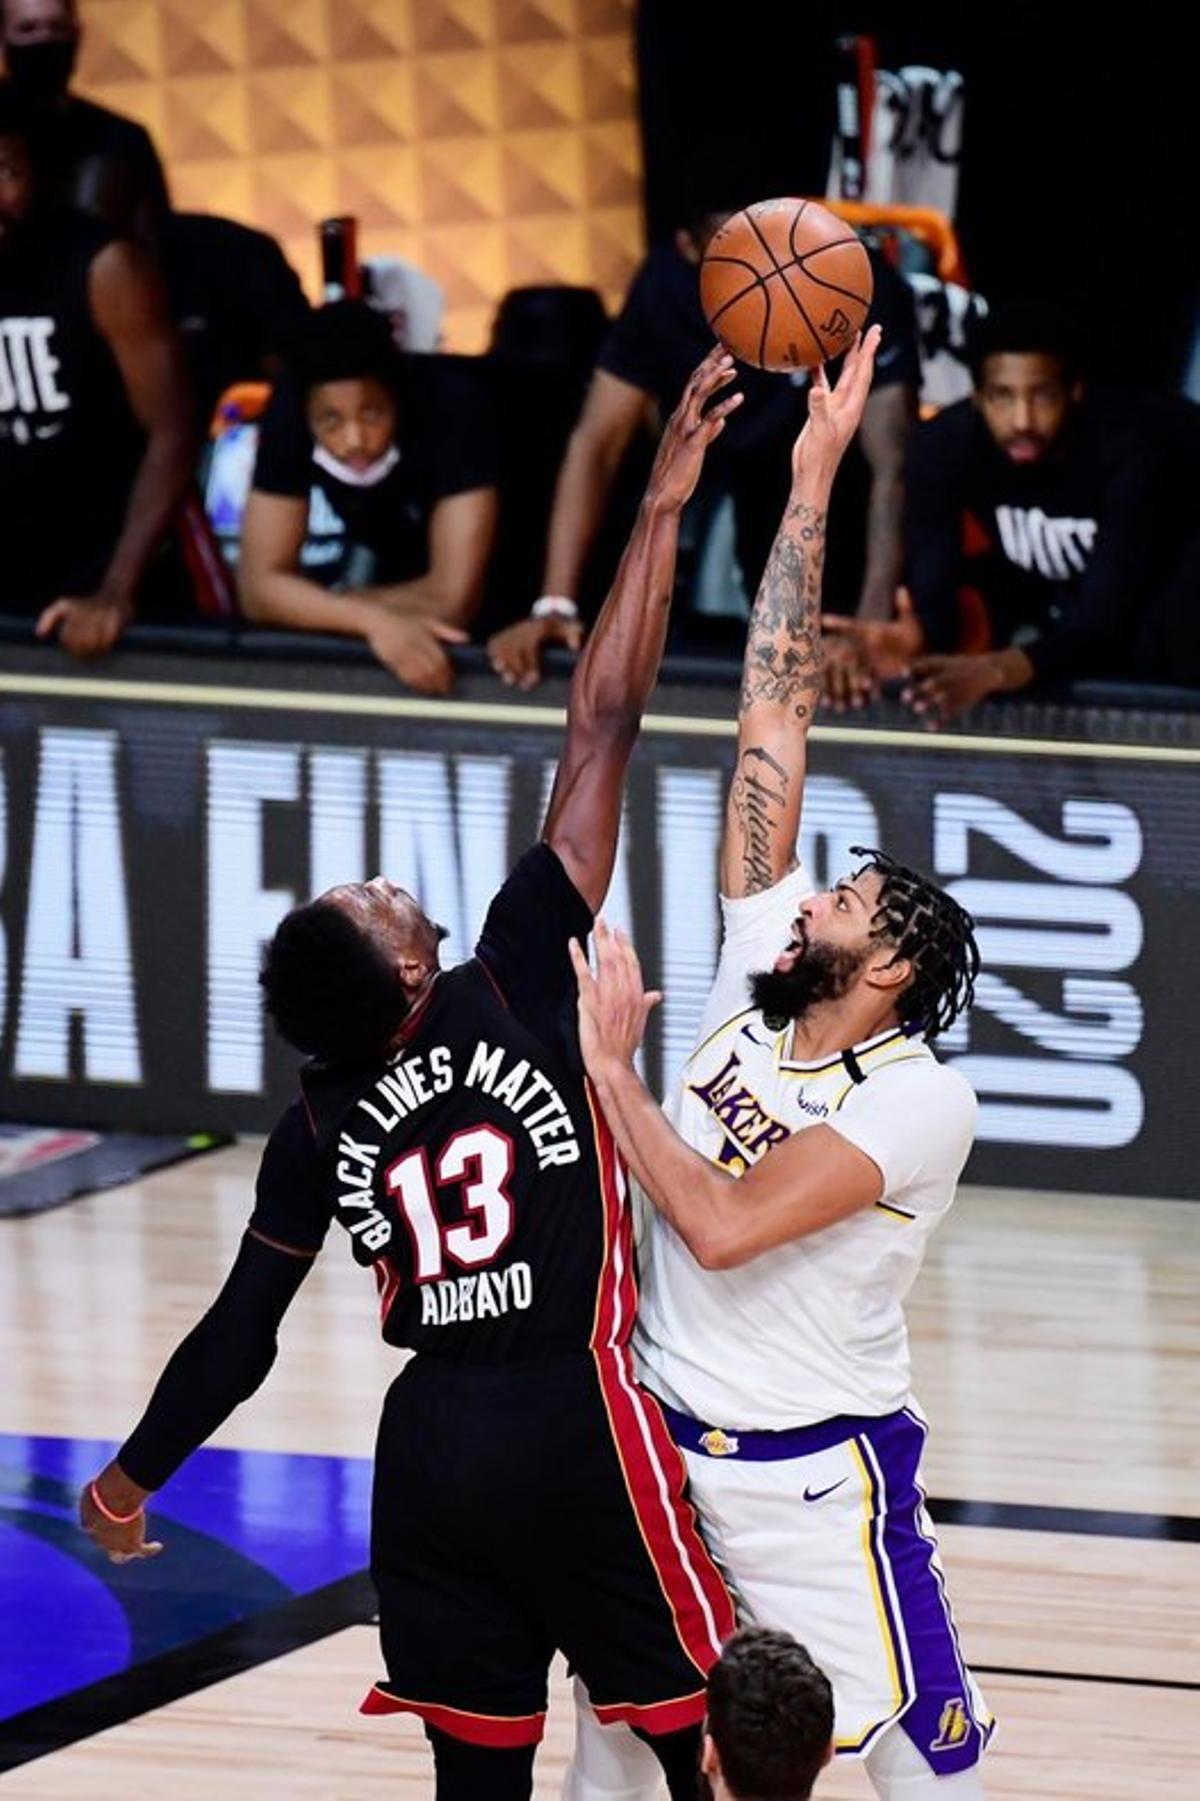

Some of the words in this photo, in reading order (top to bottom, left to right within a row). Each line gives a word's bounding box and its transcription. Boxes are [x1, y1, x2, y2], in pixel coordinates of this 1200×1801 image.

[0, 726, 144, 1086] A
[933, 791, 1145, 1150] 2020
[357, 1045, 453, 1134] LIVES
[463, 1040, 582, 1171] MATTER
[688, 1050, 792, 1156] LAKER
[336, 1131, 393, 1251] BLACK
[384, 1122, 516, 1285] 13
